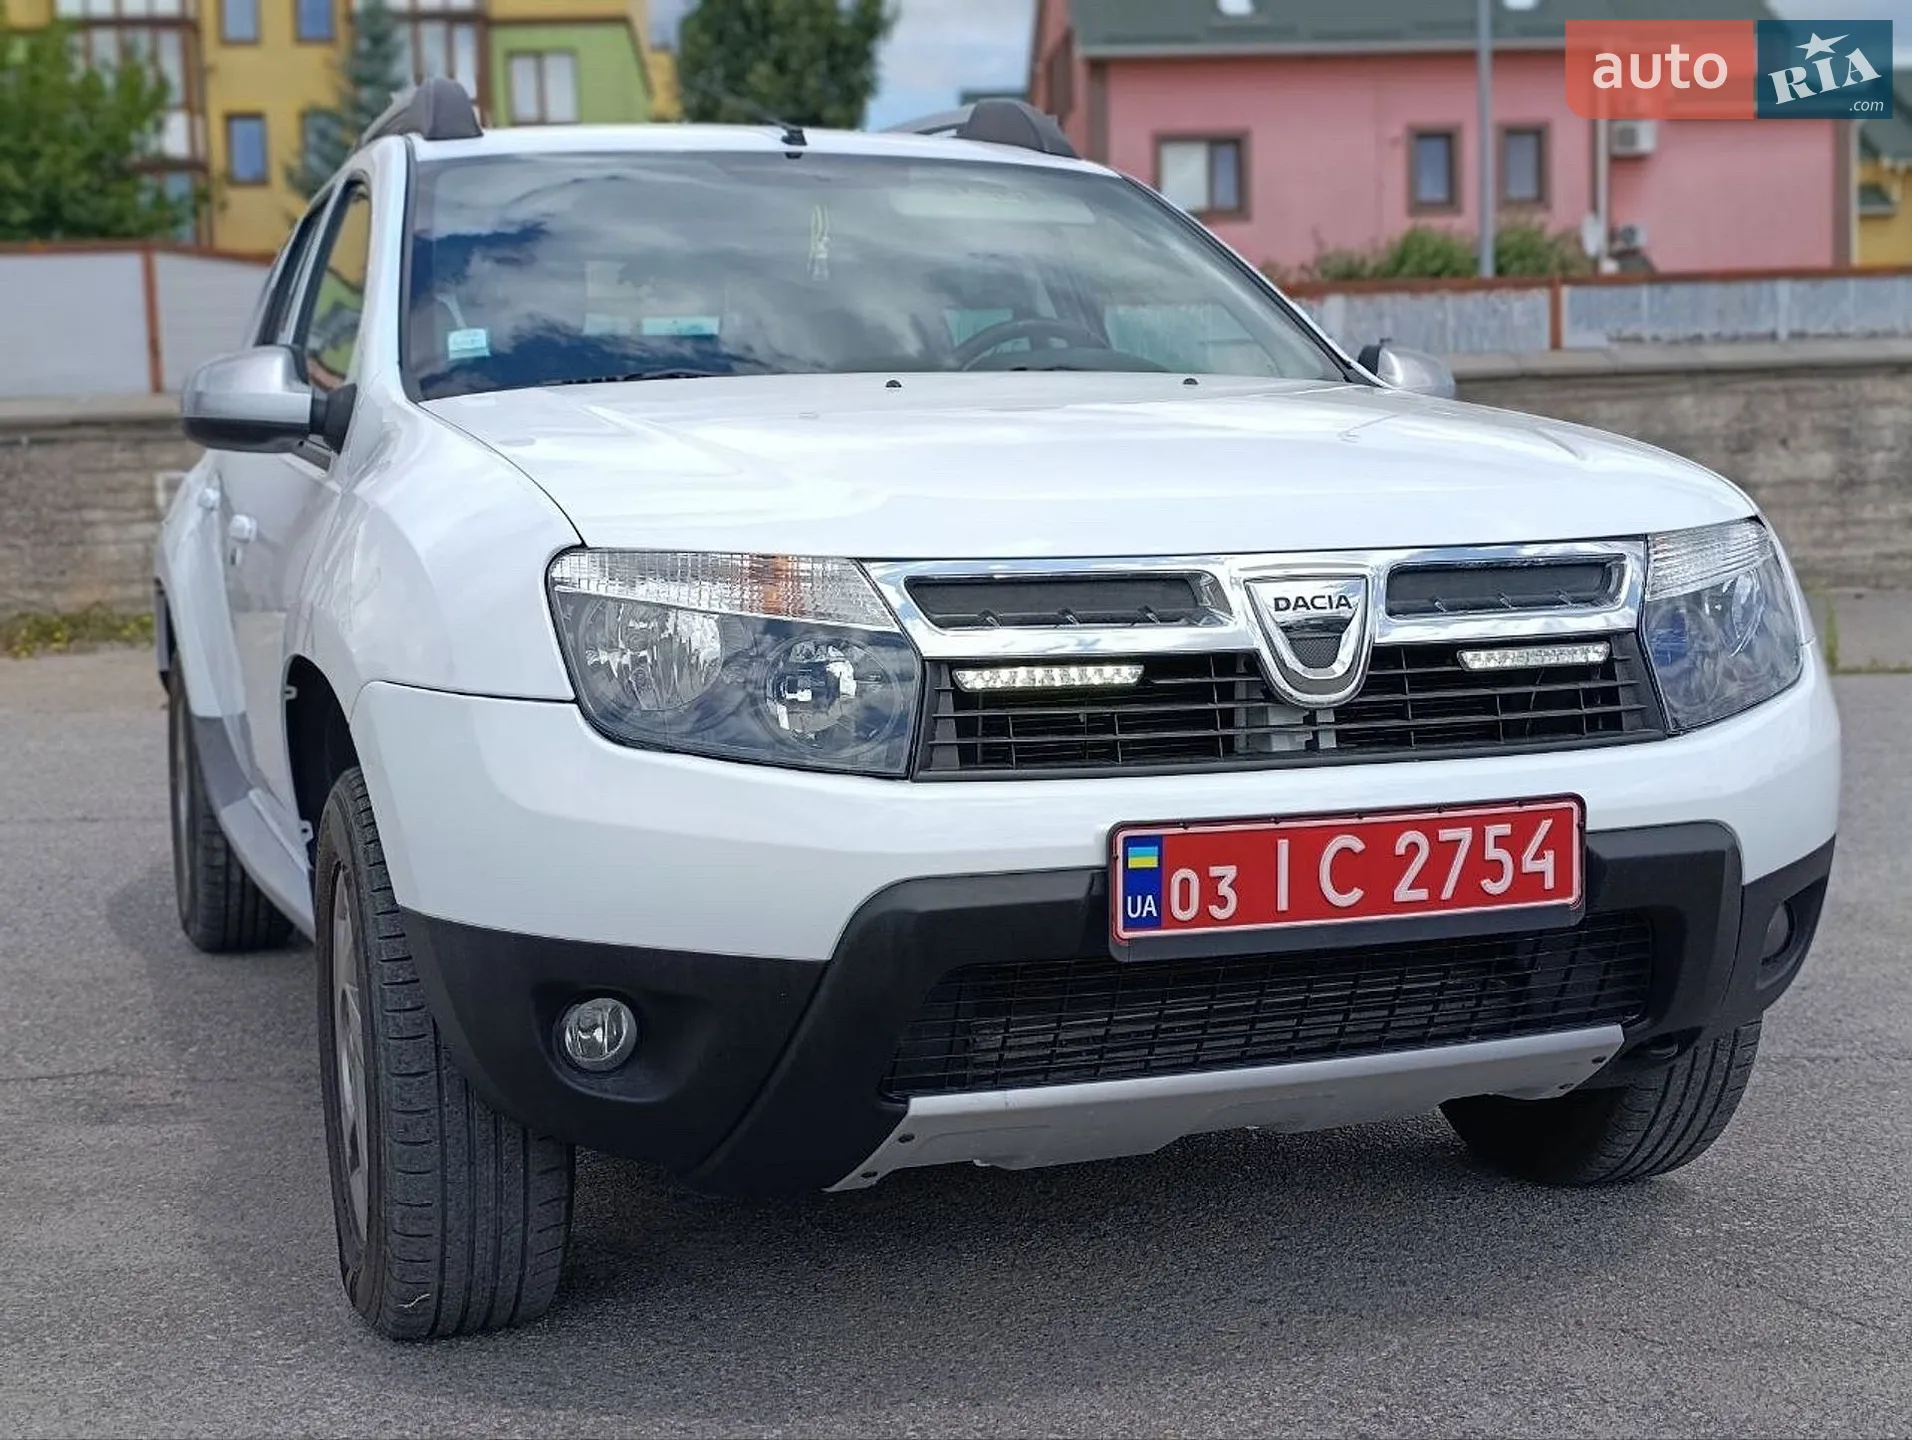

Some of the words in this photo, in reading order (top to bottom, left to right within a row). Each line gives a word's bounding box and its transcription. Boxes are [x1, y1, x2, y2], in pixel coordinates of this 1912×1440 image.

[1273, 594, 1353, 612] DACIA
[1169, 864, 1239, 922] 03
[1393, 818, 1556, 904] 2754
[1126, 895, 1158, 919] UA
